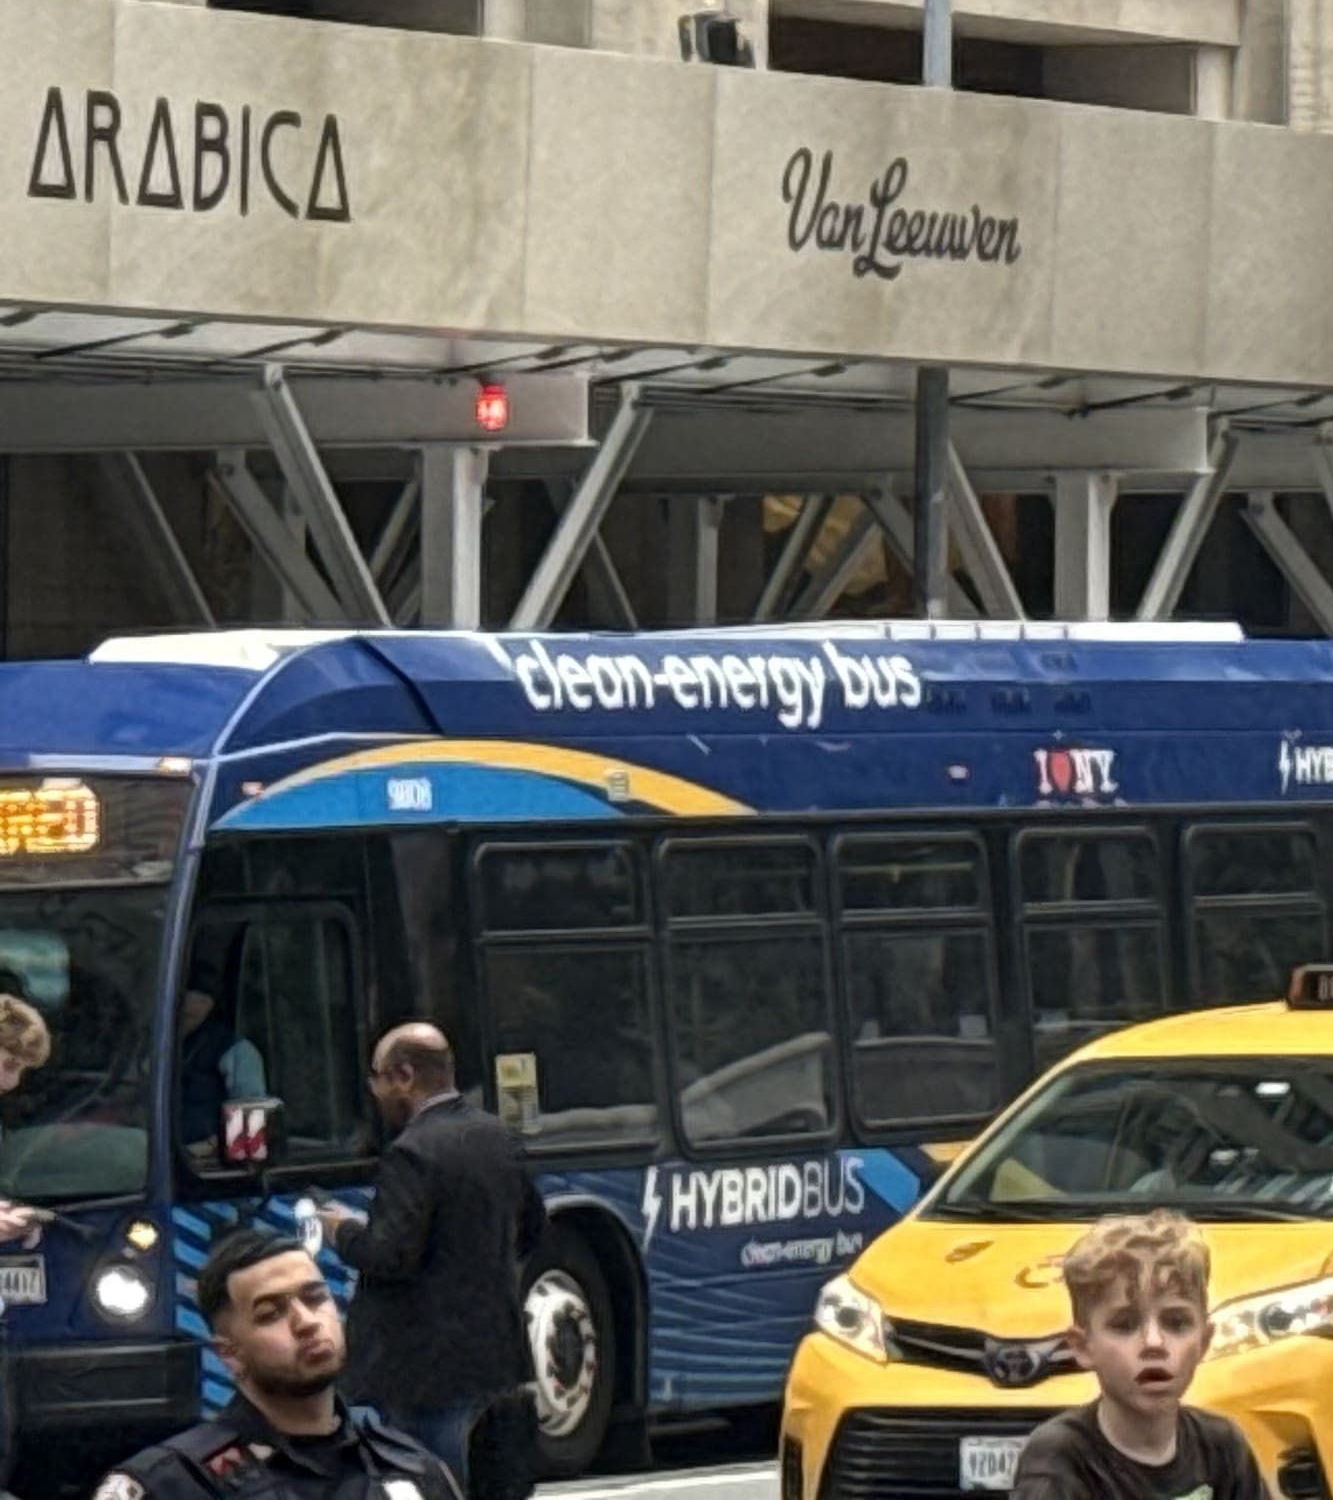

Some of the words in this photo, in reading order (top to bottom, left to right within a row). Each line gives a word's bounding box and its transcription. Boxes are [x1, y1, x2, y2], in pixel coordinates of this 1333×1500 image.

[27, 86, 353, 223] ARABICA
[782, 147, 866, 252] Van
[853, 156, 1022, 281] Leeuwen
[515, 639, 825, 729] clean-energy
[823, 639, 922, 709] bus
[1068, 747, 1119, 794] NY
